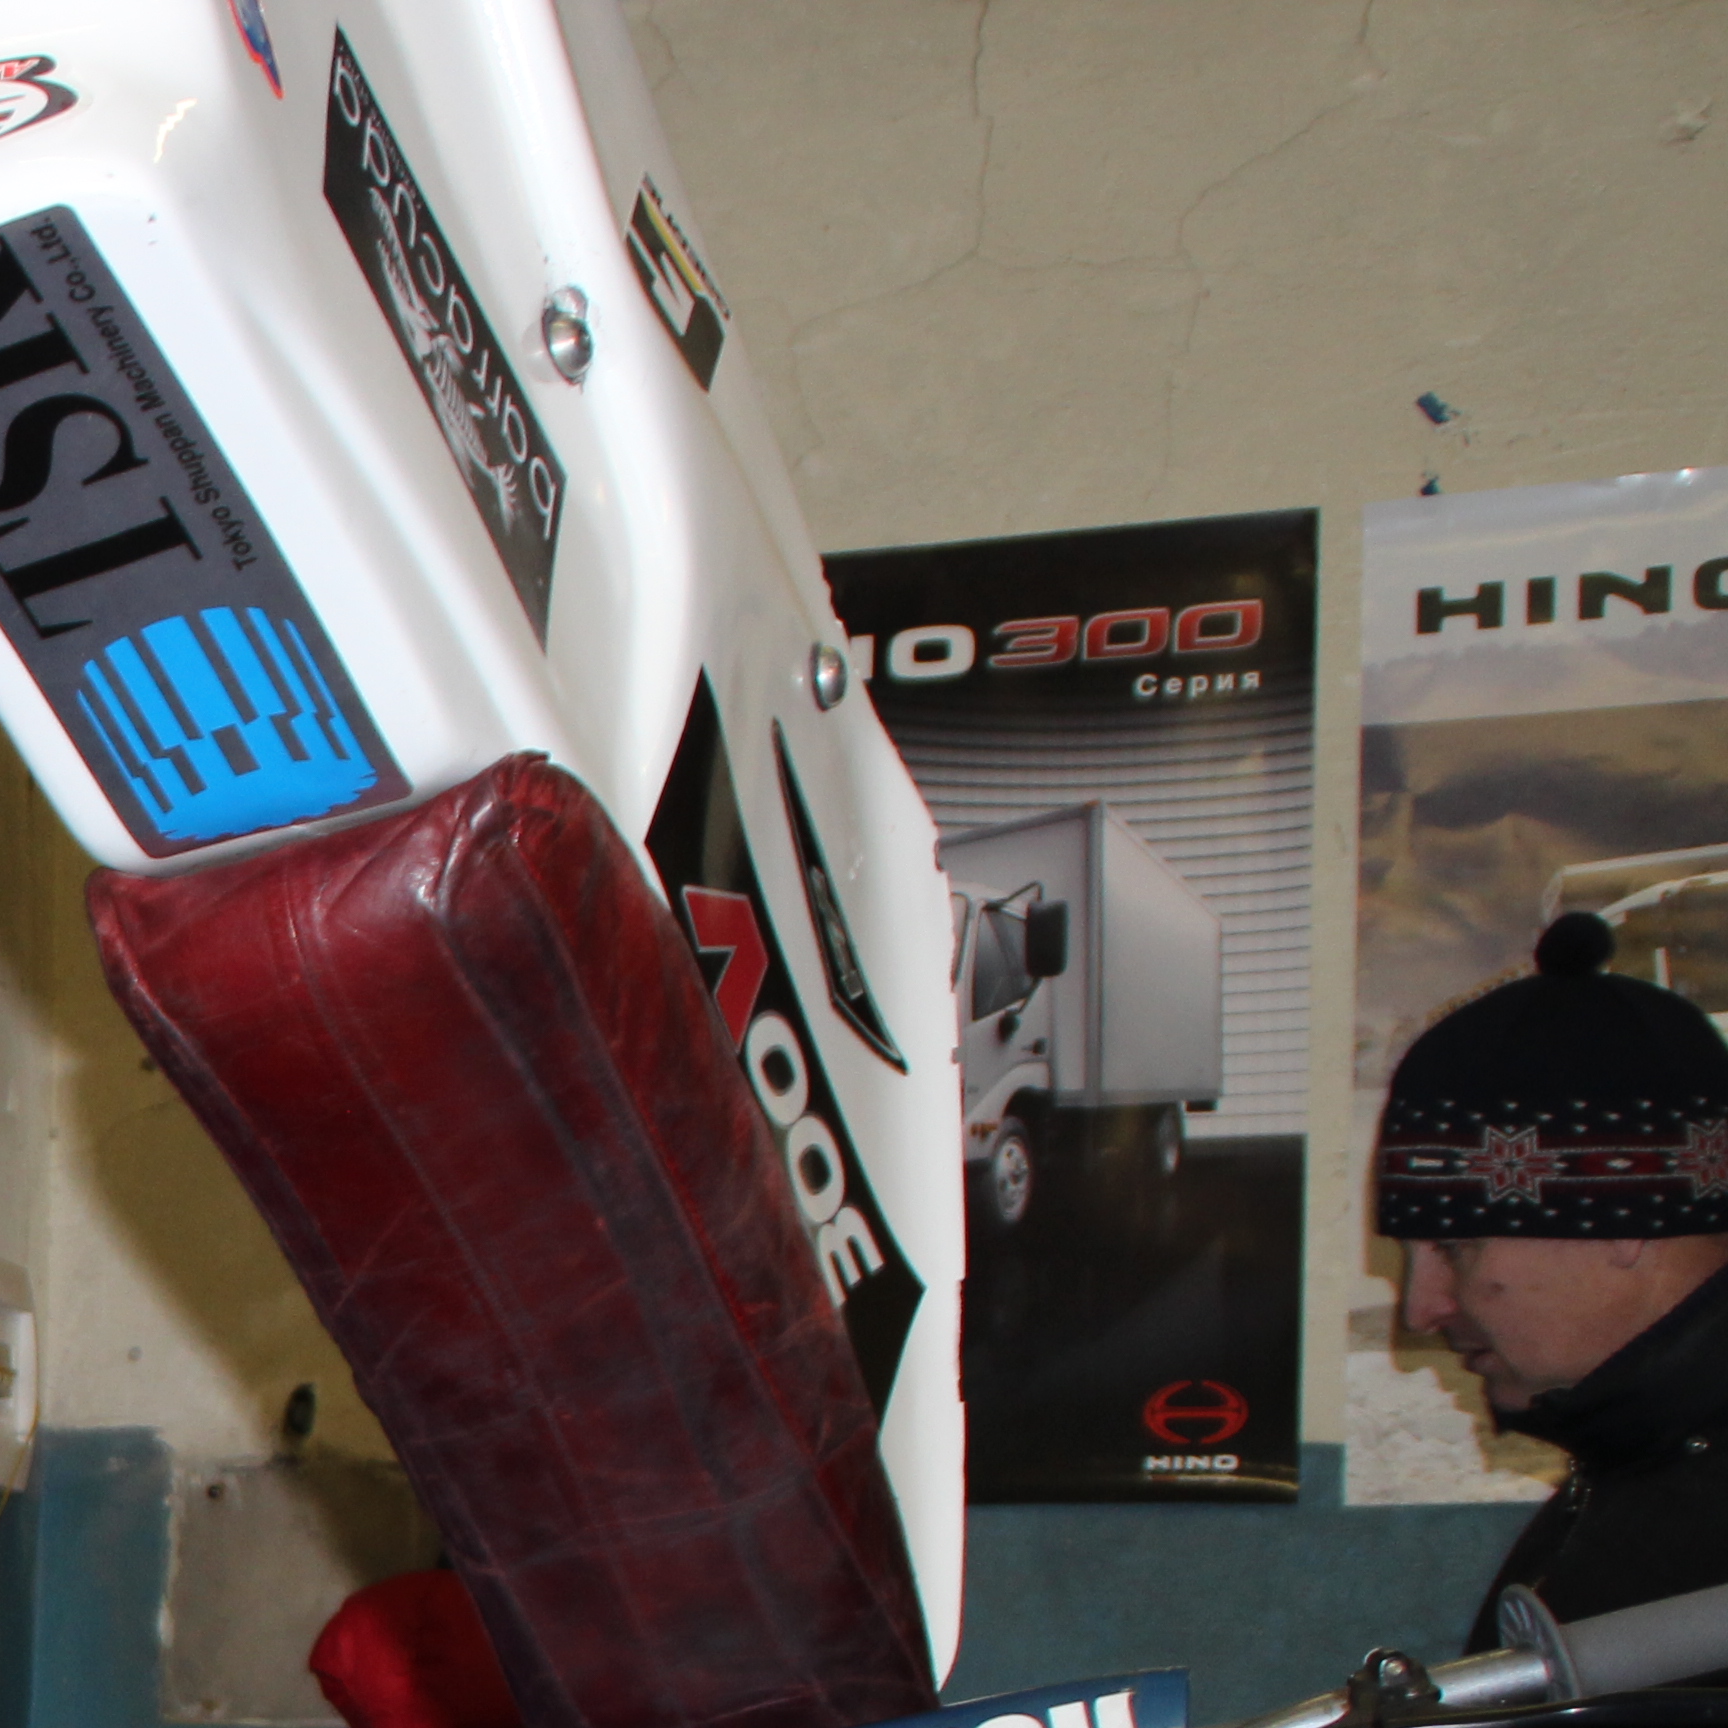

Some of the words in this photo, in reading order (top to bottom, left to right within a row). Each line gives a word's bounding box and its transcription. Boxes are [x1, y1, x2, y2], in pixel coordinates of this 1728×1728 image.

[334, 56, 557, 538] barracuda
[86, 302, 165, 413] Machinery
[154, 409, 224, 505] Shuppan
[208, 503, 259, 570] Tokyo
[1134, 669, 1261, 700] Серия
[1144, 1453, 1241, 1471] HINO
